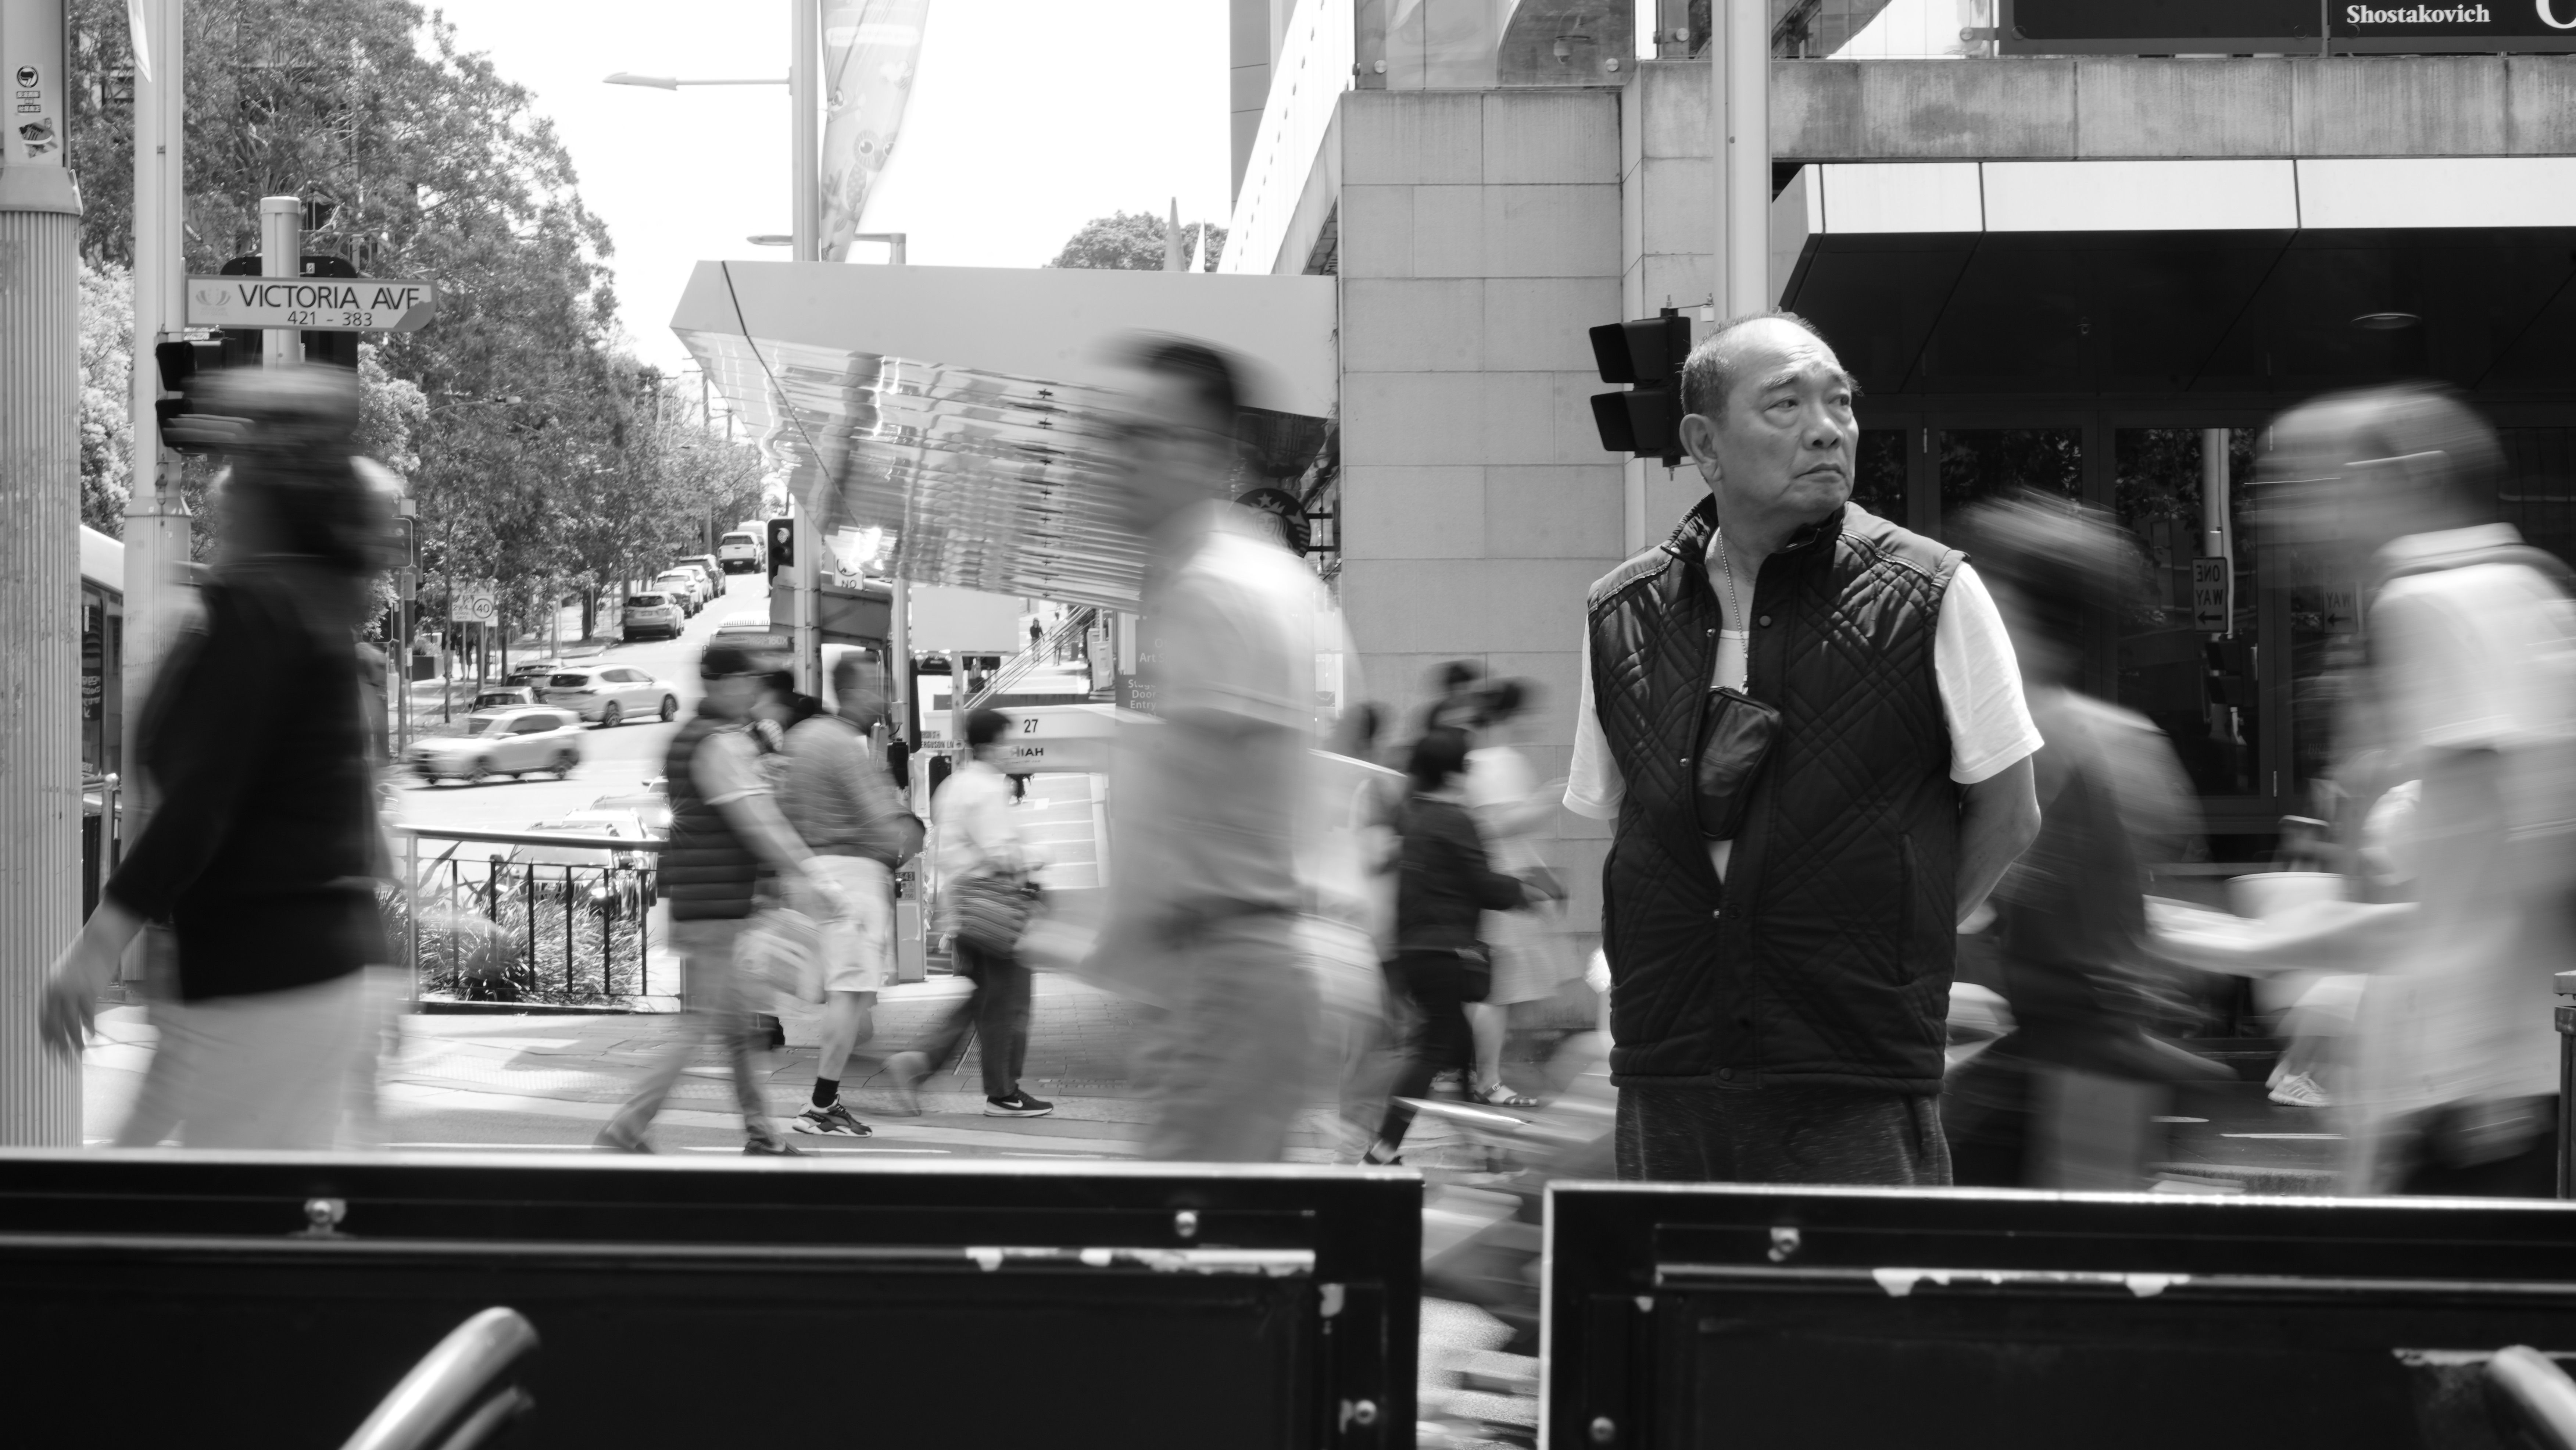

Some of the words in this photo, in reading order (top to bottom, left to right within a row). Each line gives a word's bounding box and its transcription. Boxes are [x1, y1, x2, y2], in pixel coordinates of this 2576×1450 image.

[2347, 4, 2491, 24] Shostakovich
[239, 284, 360, 309] VICTORIA
[287, 311, 316, 325] 421
[342, 312, 373, 326] 383
[476, 604, 490, 613] 40
[1132, 690, 1157, 699] Door
[1130, 700, 1157, 711] Entry
[1024, 719, 1039, 733] 27
